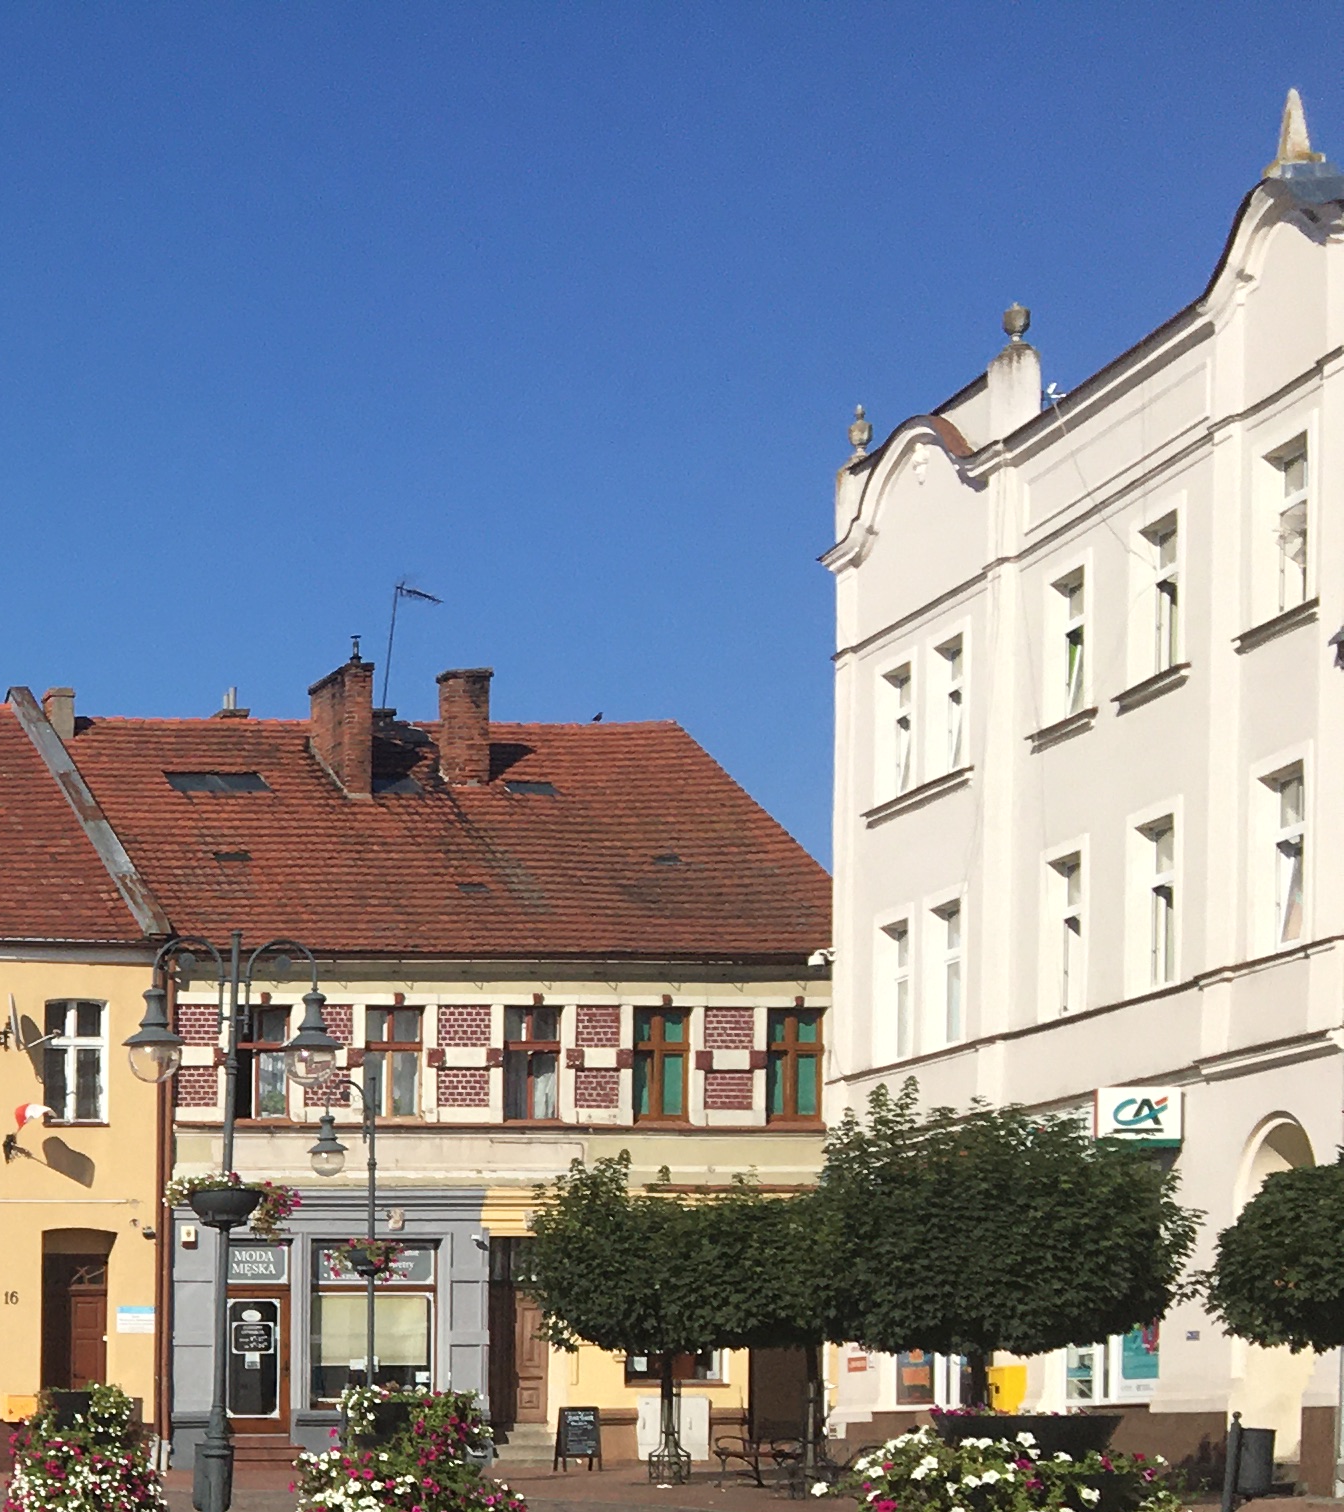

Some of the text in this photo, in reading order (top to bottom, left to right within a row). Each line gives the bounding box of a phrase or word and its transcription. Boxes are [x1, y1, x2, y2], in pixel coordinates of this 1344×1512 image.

[234, 1250, 274, 1261] MODA
[232, 1263, 276, 1276] MĘSKA
[4, 1291, 19, 1305] 16
